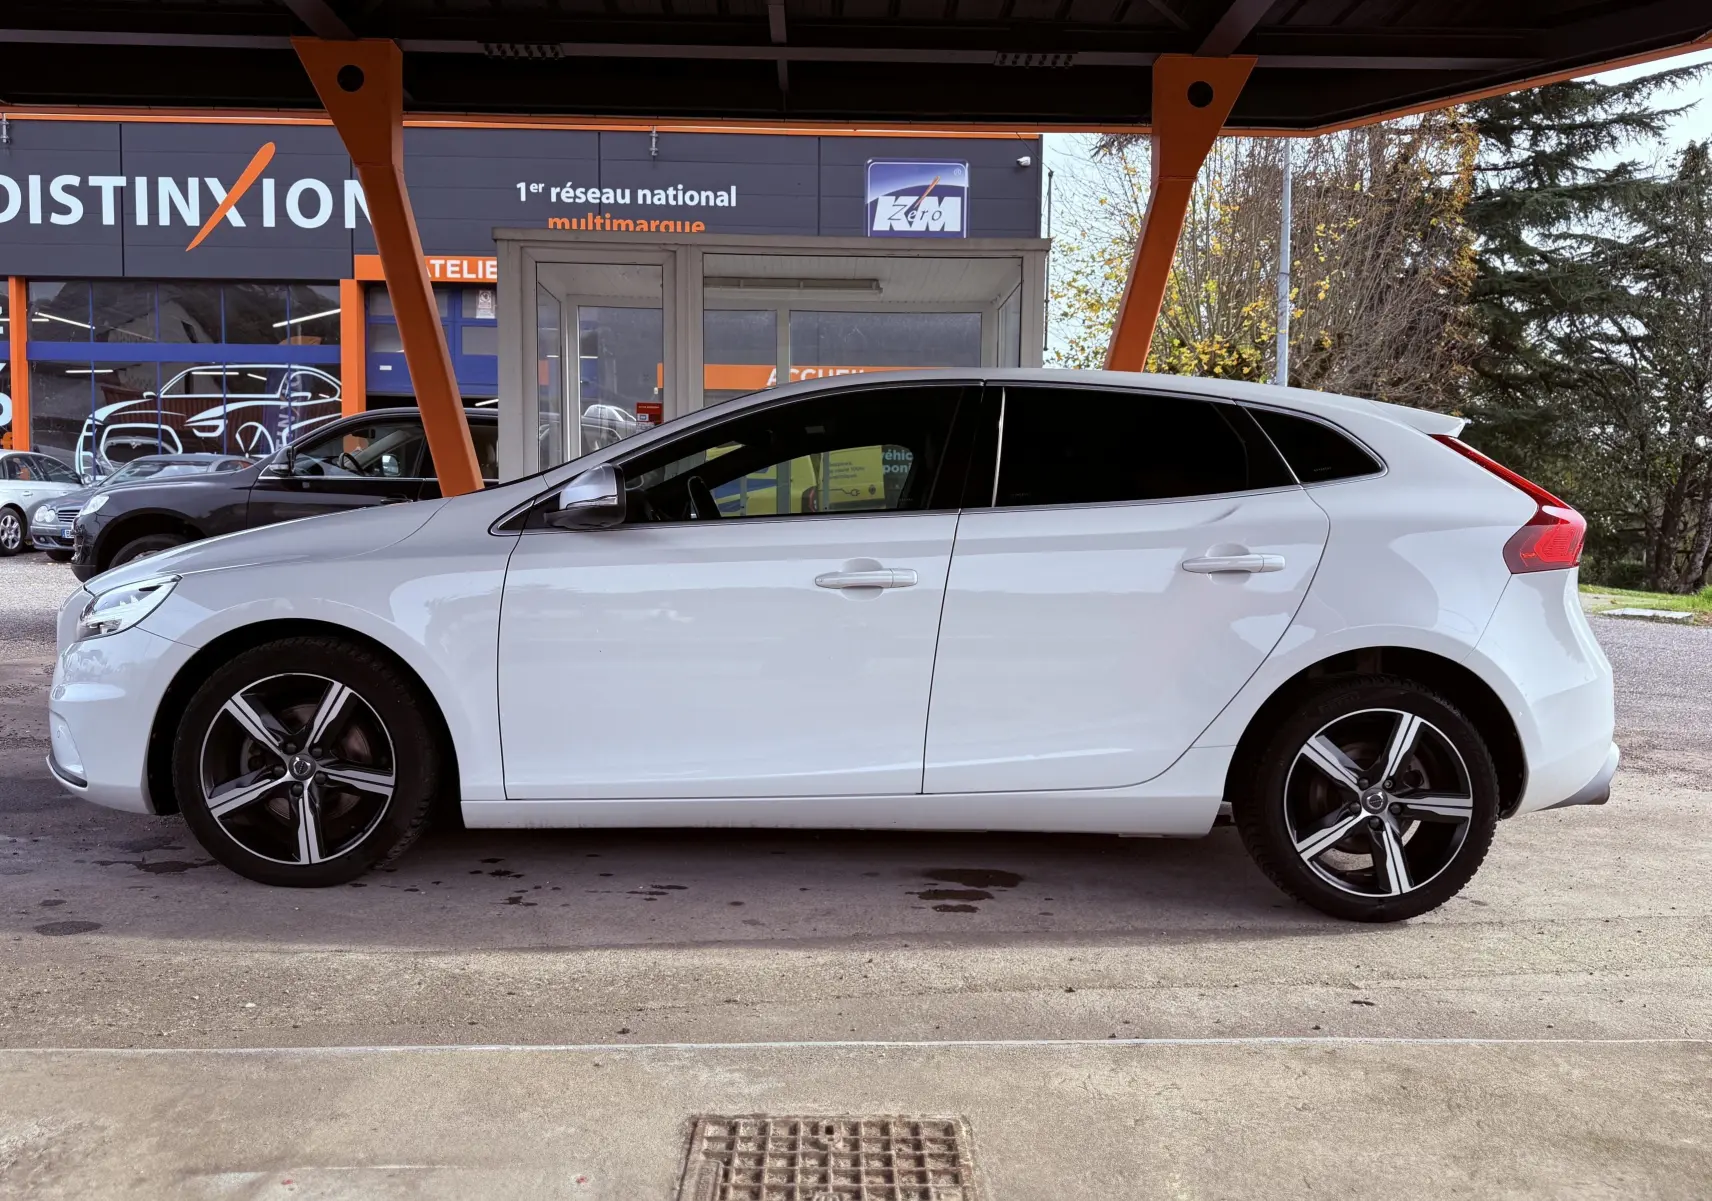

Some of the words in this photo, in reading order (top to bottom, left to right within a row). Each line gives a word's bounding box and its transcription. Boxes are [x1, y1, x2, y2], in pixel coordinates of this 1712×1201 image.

[516, 182, 545, 202] 1er
[550, 182, 630, 204] réseau
[637, 184, 737, 207] national
[426, 259, 498, 279] TELIE
